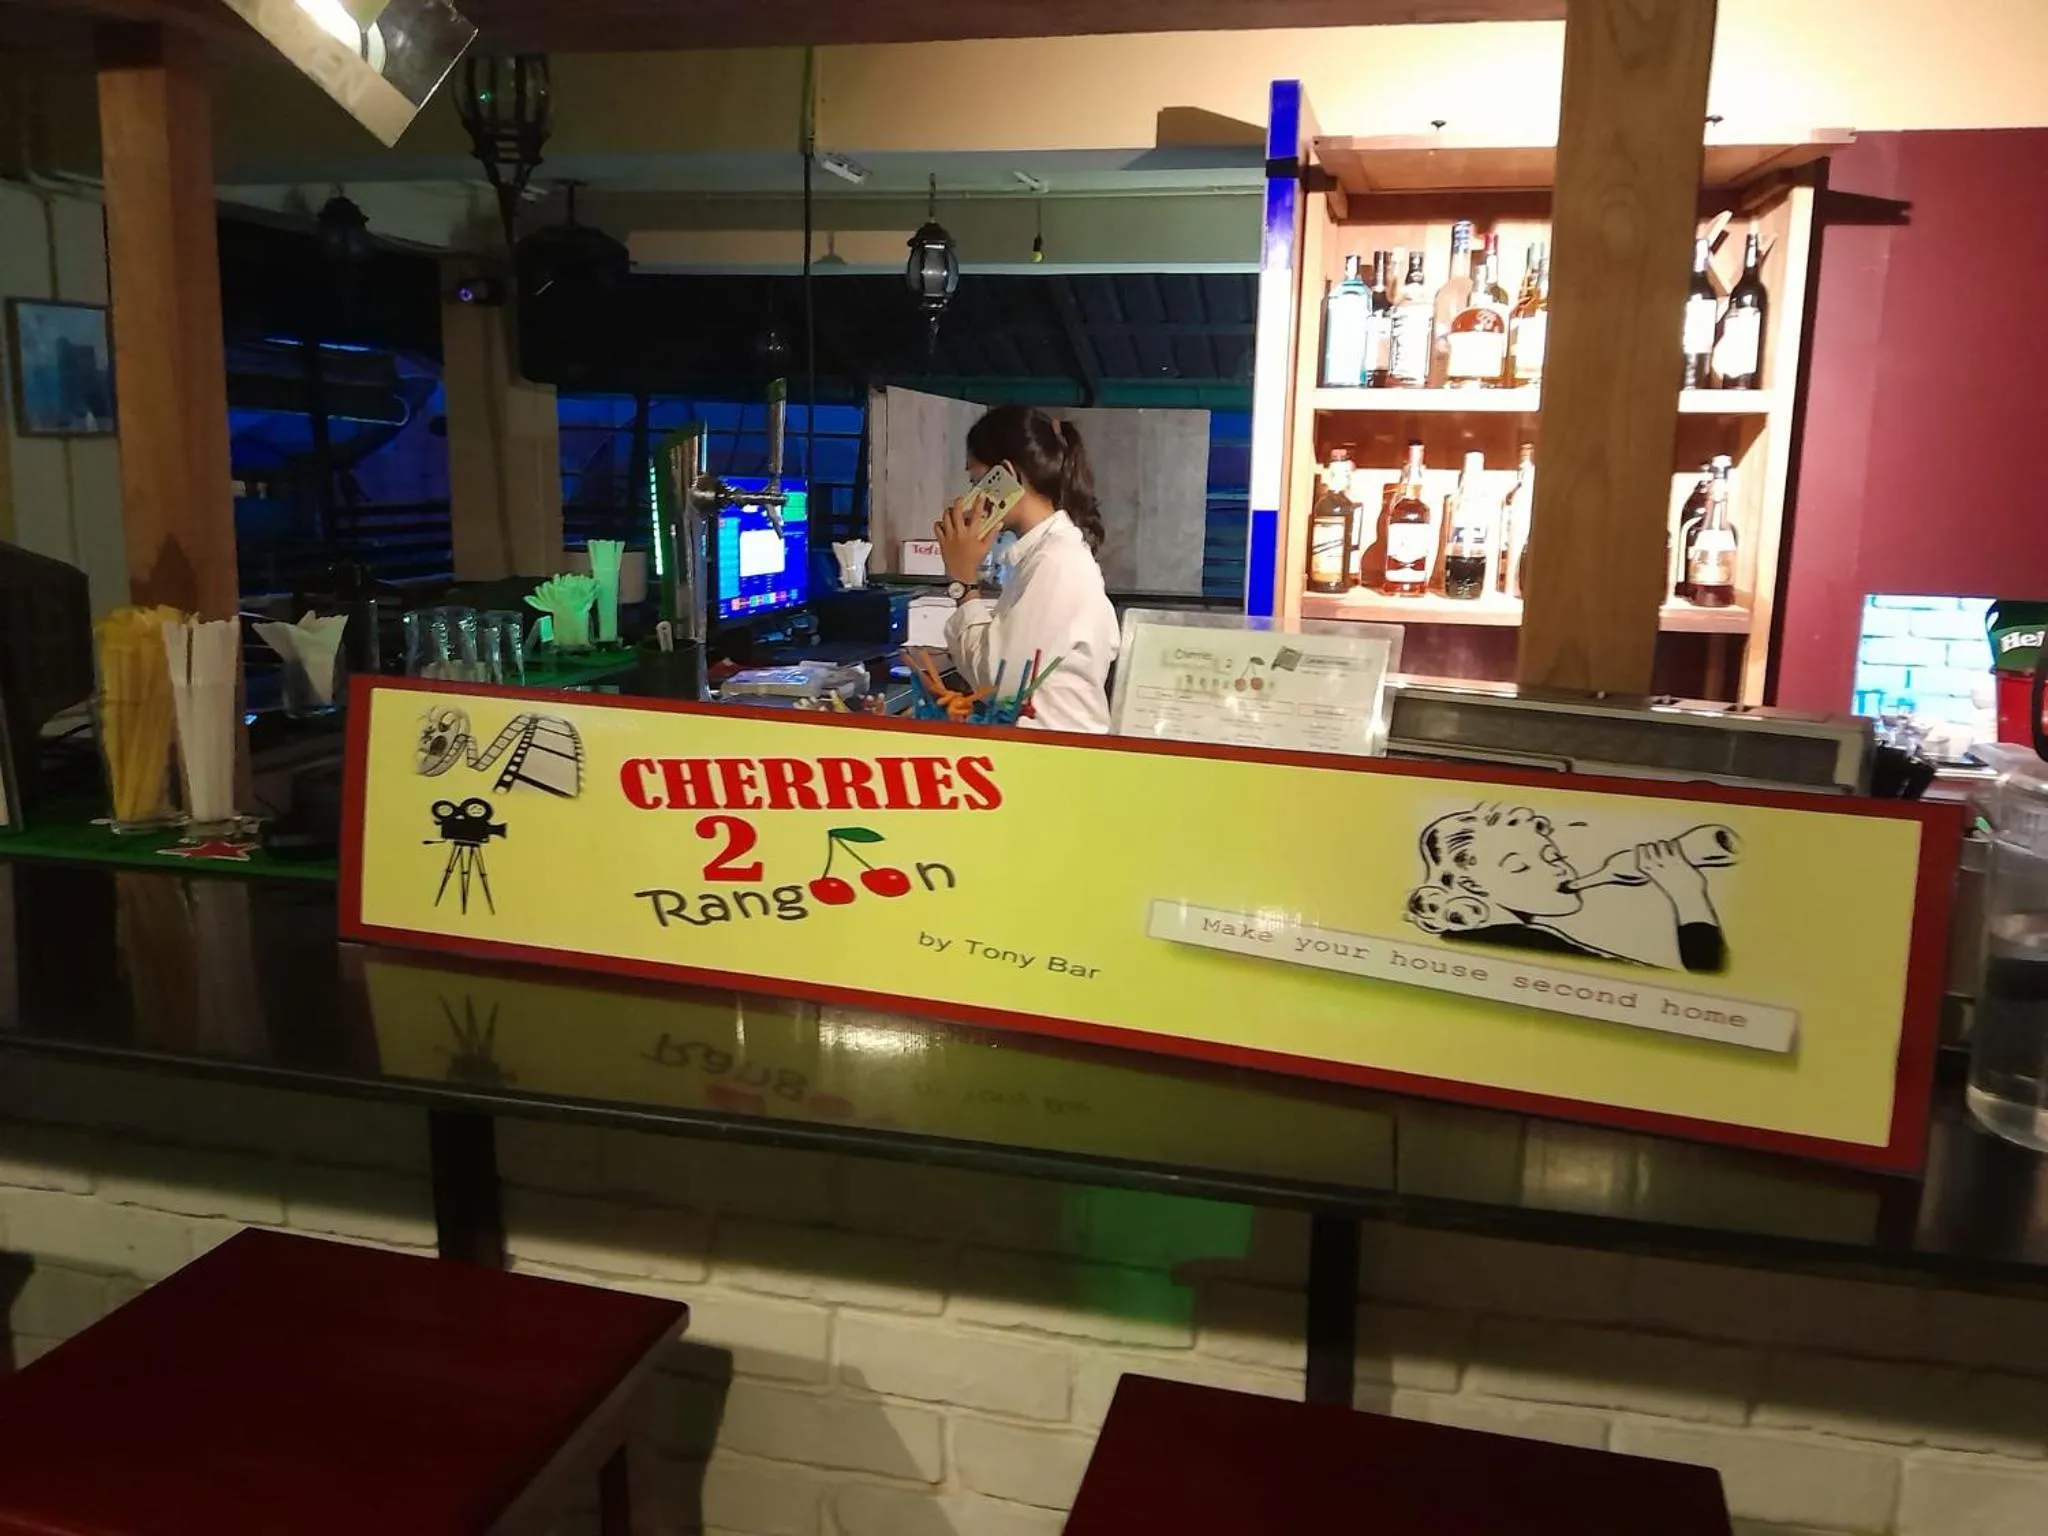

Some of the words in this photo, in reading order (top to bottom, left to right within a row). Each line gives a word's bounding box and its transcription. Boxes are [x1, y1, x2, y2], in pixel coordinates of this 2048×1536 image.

[619, 755, 1003, 811] CHERRIES
[695, 814, 763, 883] 2
[918, 930, 951, 952] by
[965, 938, 1036, 969] Tony
[1048, 956, 1101, 981] Bar
[1201, 916, 1274, 944] Make
[1294, 935, 1370, 961] your
[1389, 949, 1489, 982] house
[1512, 973, 1640, 1009] second
[1660, 997, 1750, 1029] home
